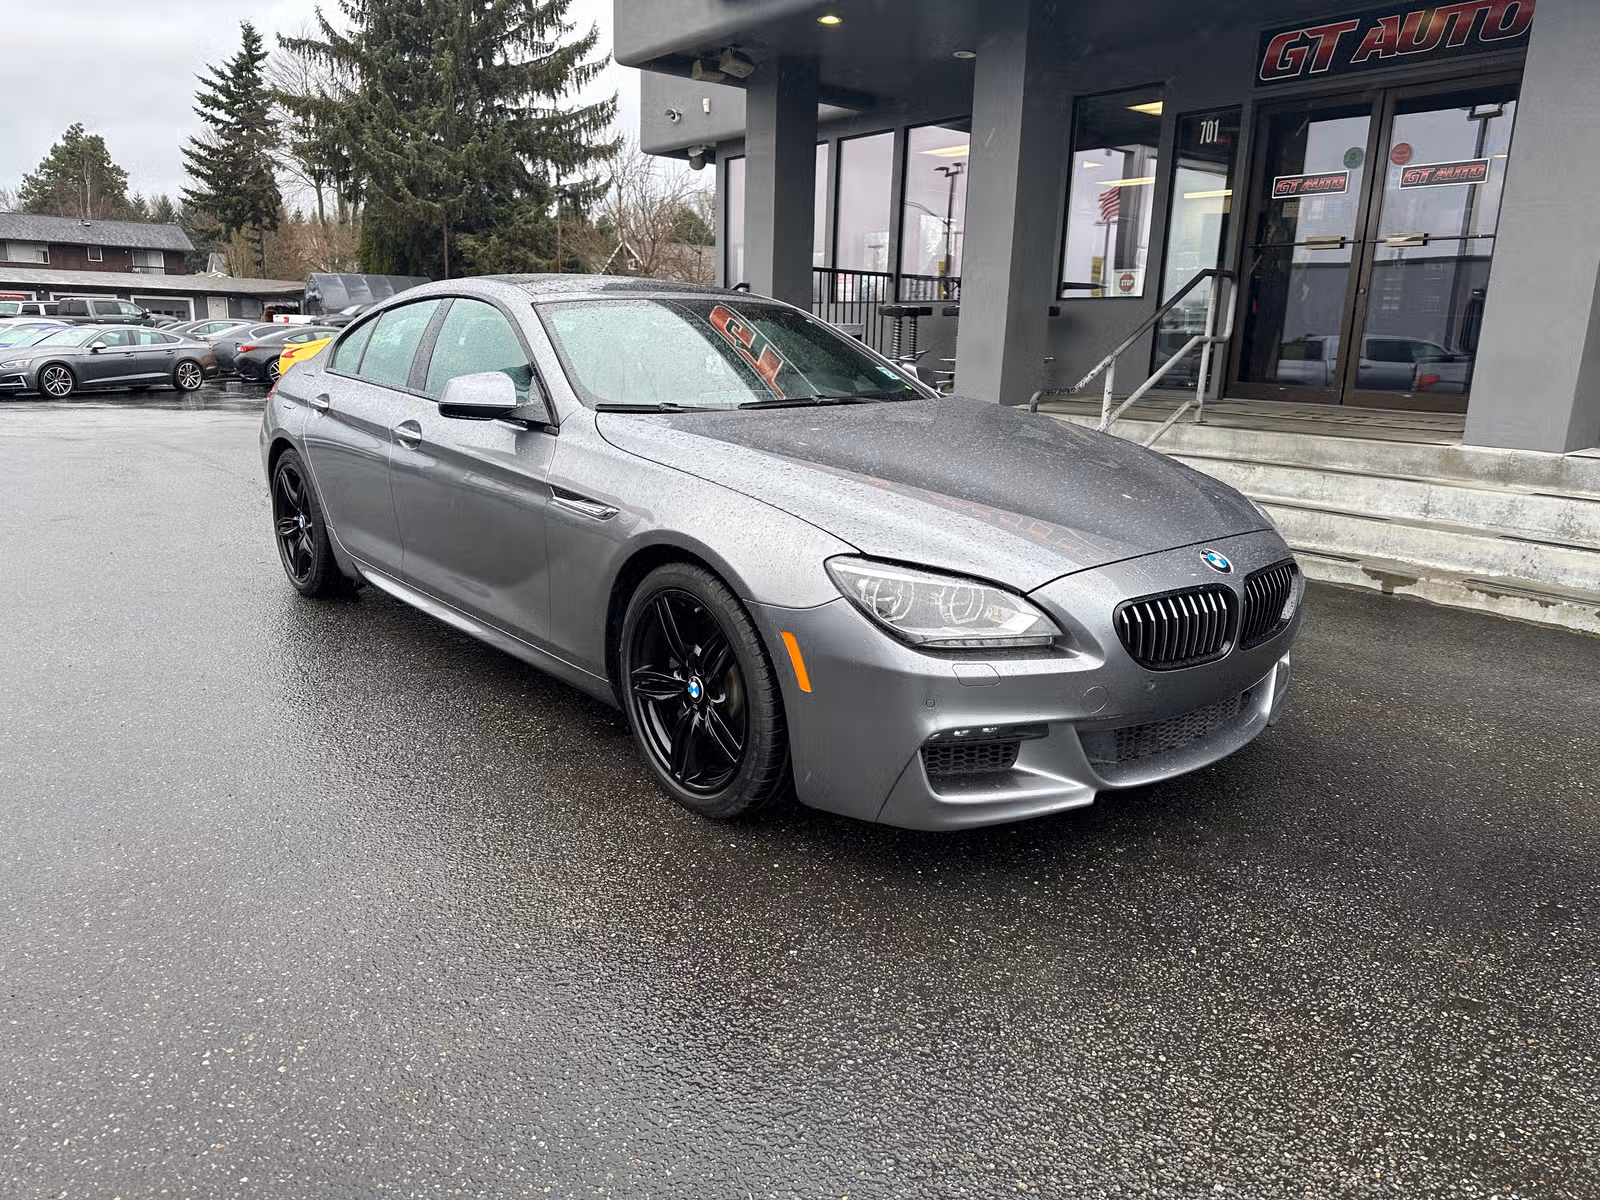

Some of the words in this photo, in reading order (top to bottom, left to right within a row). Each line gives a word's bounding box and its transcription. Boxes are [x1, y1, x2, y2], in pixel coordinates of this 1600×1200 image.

[1260, 18, 1360, 81] GT
[1350, 0, 1537, 63] AUTO
[1200, 119, 1219, 144] 701
[1403, 168, 1435, 184] GT
[1432, 165, 1485, 181] AUTO
[1275, 179, 1303, 194] GT
[1300, 176, 1345, 191] AUTO
[1120, 279, 1134, 287] STOP
